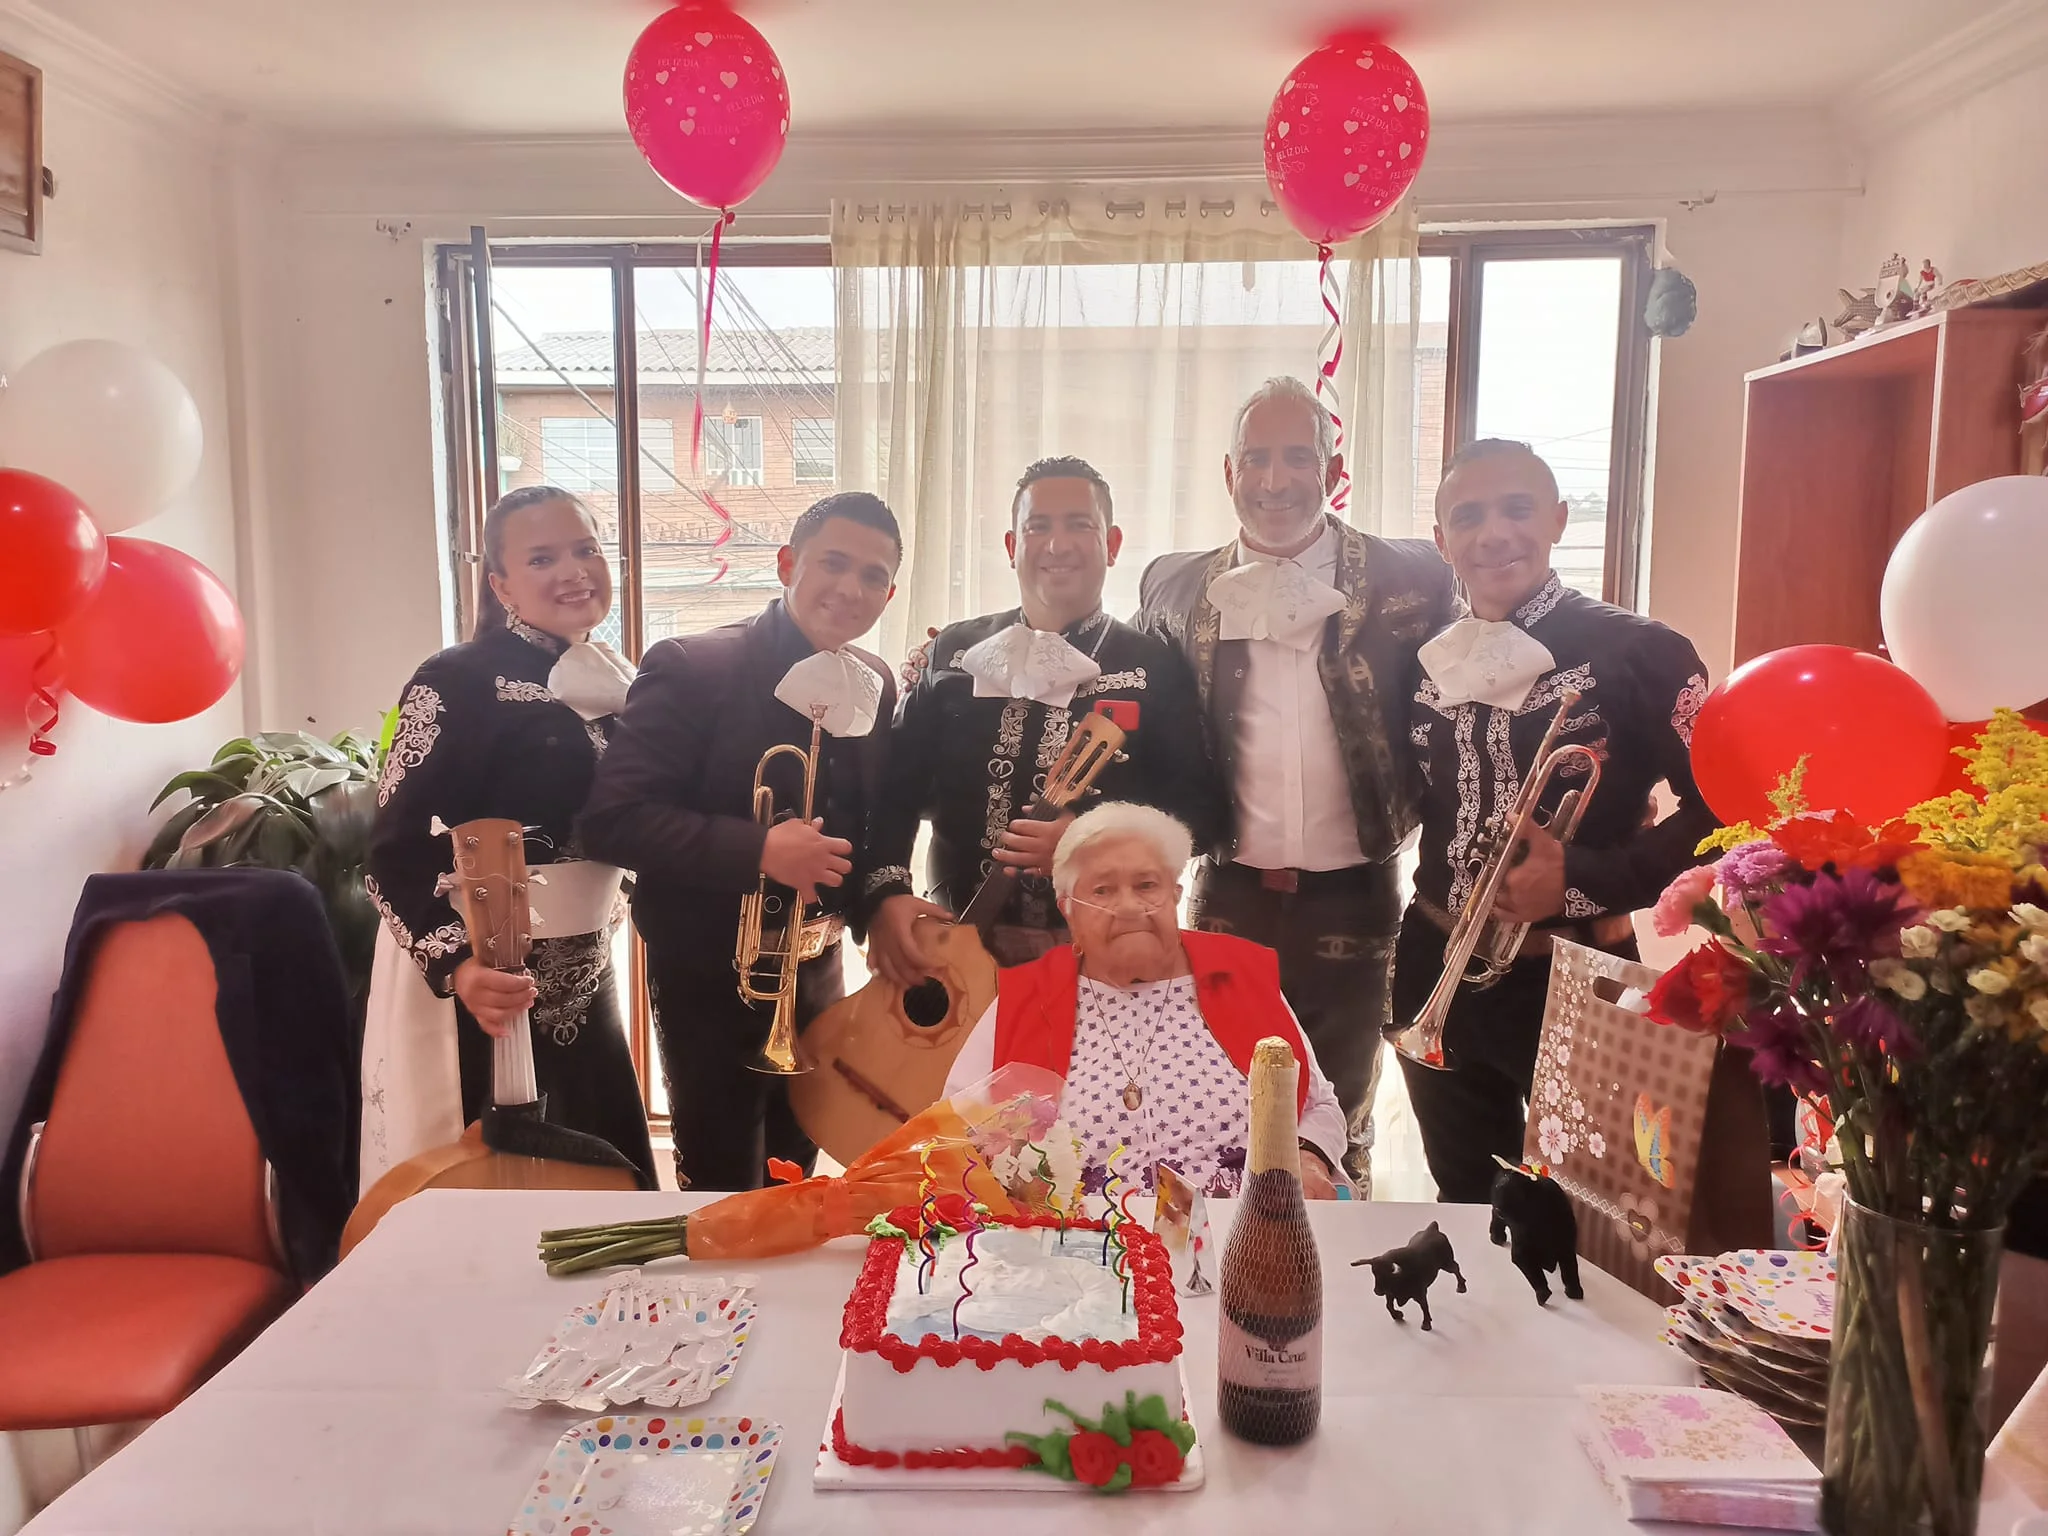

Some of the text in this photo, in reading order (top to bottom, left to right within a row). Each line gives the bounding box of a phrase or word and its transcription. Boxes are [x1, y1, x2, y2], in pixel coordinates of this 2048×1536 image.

[1350, 106, 1390, 133] FELIZ DIA
[1276, 144, 1310, 162] FELIZ DIA
[1245, 1344, 1275, 1363] Villa
